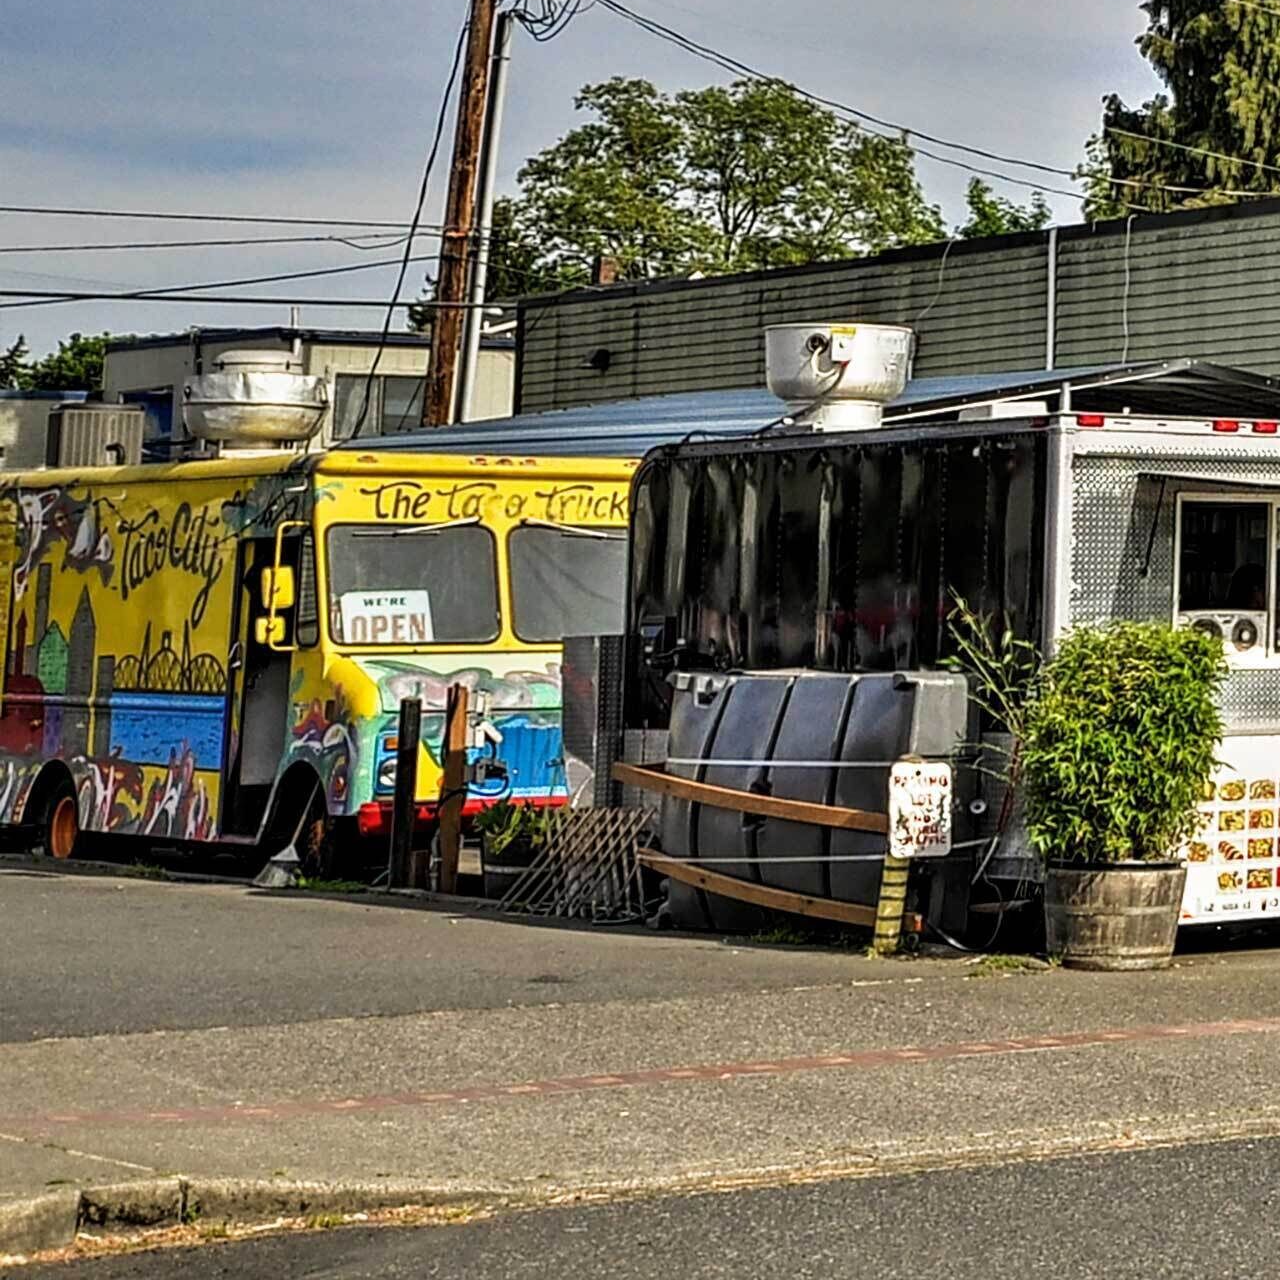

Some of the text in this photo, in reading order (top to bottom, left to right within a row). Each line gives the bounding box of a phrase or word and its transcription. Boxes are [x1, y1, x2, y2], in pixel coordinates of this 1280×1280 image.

[117, 509, 167, 601] Taco
[169, 501, 223, 630] City
[363, 596, 407, 608] WE'RE
[352, 613, 426, 642] OPEN
[894, 775, 948, 787] PAING
